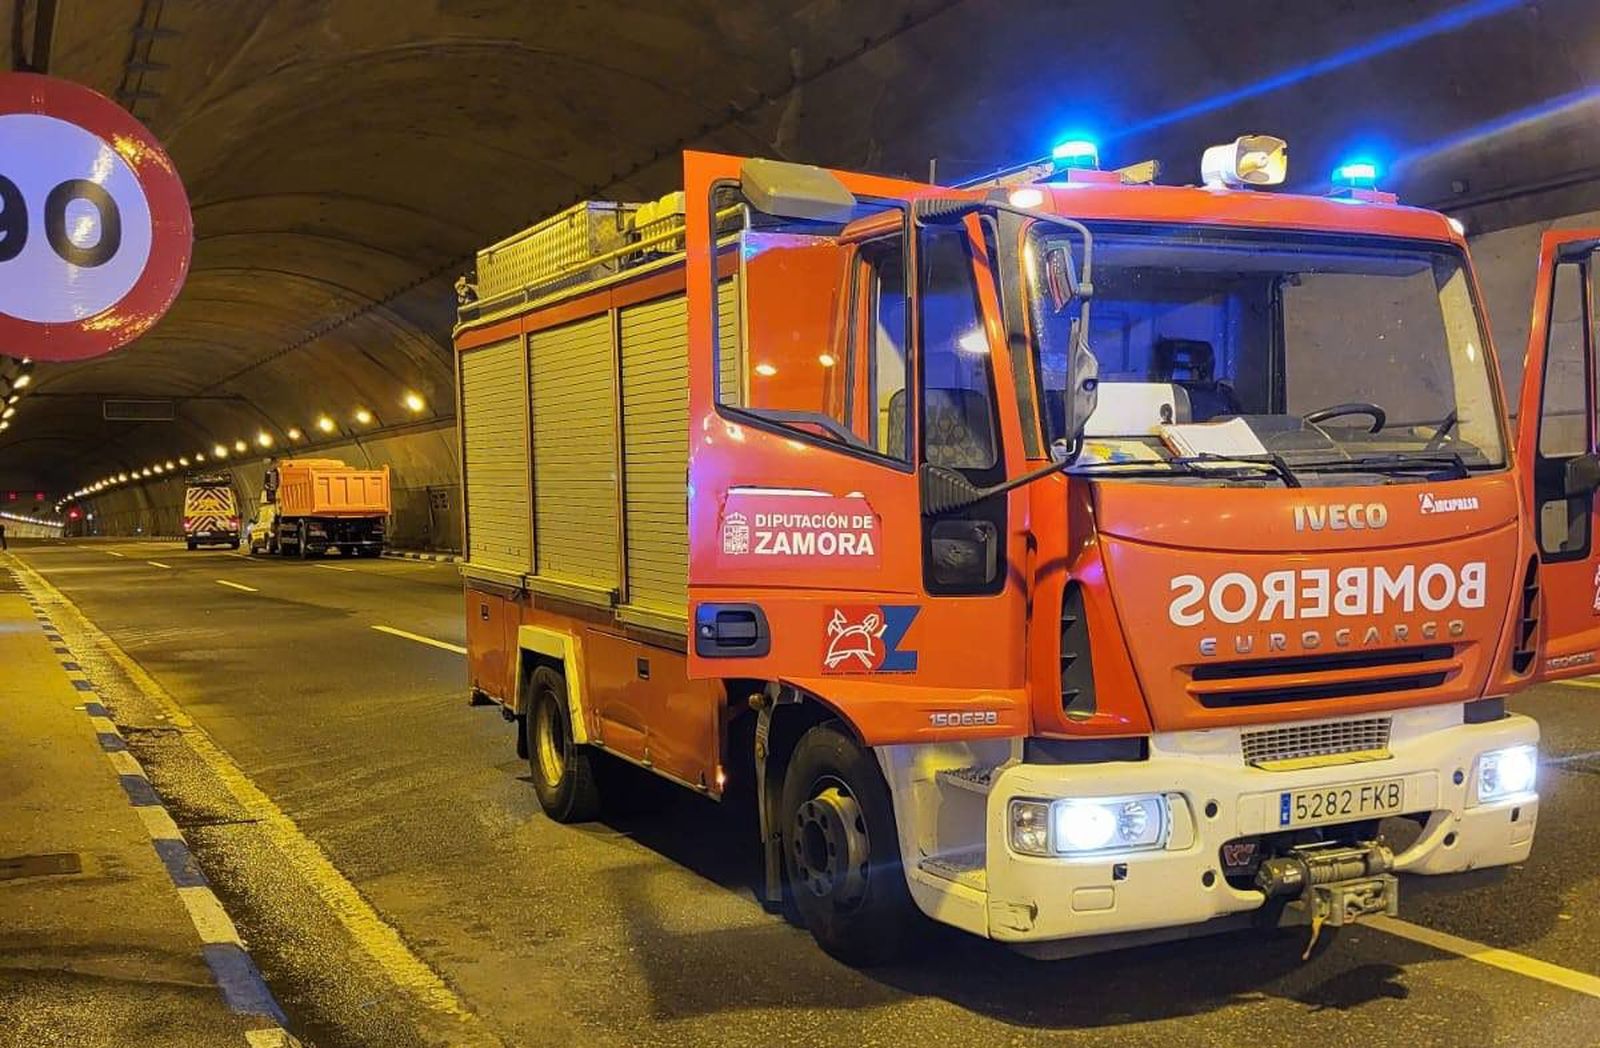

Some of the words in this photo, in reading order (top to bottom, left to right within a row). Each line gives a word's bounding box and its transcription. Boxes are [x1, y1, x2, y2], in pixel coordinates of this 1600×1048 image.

[755, 513, 848, 528] DIPUTACIÓN
[852, 515, 873, 529] DE
[1293, 503, 1388, 531] IVECO
[754, 531, 874, 556] ZAMORA
[1200, 620, 1464, 656] EUROCARGO
[1296, 790, 1352, 819] 5282
[1360, 784, 1400, 811] FKB
